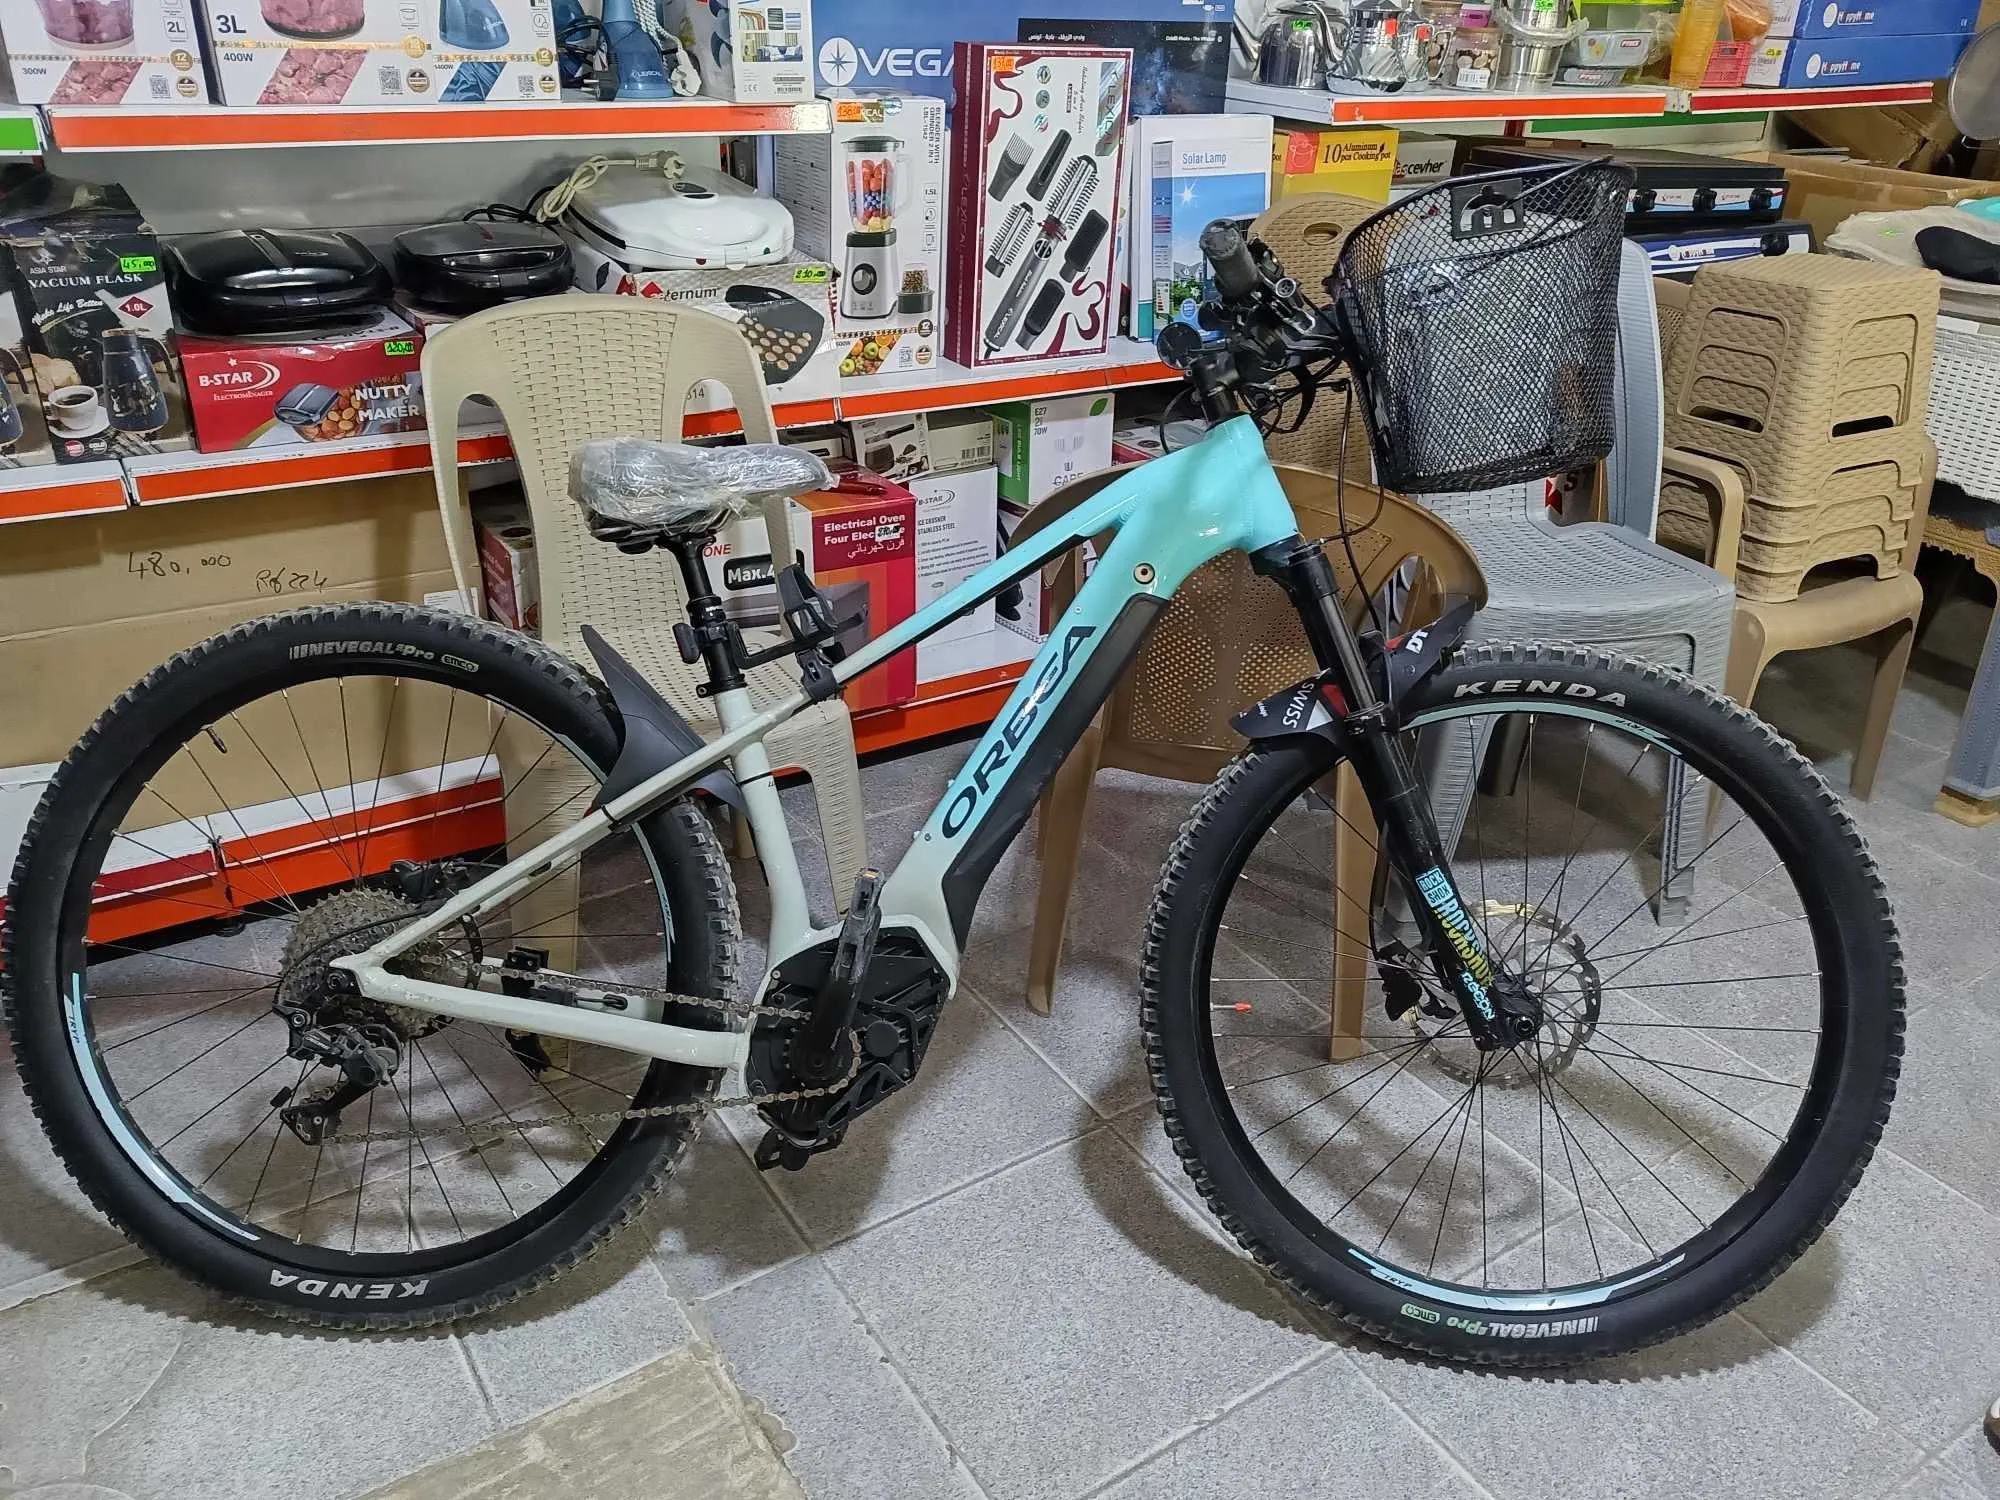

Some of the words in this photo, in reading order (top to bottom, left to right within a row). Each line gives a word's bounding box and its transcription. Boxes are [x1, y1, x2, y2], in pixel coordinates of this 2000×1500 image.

[166, 21, 186, 33] 2L
[215, 14, 247, 34] 3L
[223, 52, 253, 62] 400W
[22, 67, 47, 75] 300W
[1182, 152, 1204, 165] Solar
[1204, 152, 1227, 166] Lamp
[1322, 143, 1342, 164] 10
[1343, 142, 1378, 152] Aluminum
[1353, 151, 1380, 162] Cooking
[1380, 151, 1391, 160] pot
[29, 266, 47, 275] ASIA
[48, 265, 67, 274] STAR
[28, 276, 91, 289] VACUUM
[95, 273, 143, 285] FLASK
[651, 286, 720, 302] ternum
[56, 302, 75, 314] Life
[125, 303, 147, 313] 1.0L
[198, 371, 253, 387] B-STAR
[355, 383, 413, 401] NUTTY
[357, 404, 421, 422] MAKER
[1034, 407, 1048, 416] E27
[823, 516, 876, 533] Electrical
[879, 514, 906, 525] Oven
[823, 534, 850, 546] Four
[886, 536, 905, 551] فرن
[703, 543, 732, 558] ONE
[1405, 628, 1429, 655] DT
[1453, 679, 1630, 708] KENDA
[1283, 682, 1315, 729] SWISS
[1419, 869, 1444, 891] ROCK
[1427, 884, 1450, 905] SHOX
[1461, 971, 1496, 1022] RECON
[269, 1268, 430, 1300] KENDA
